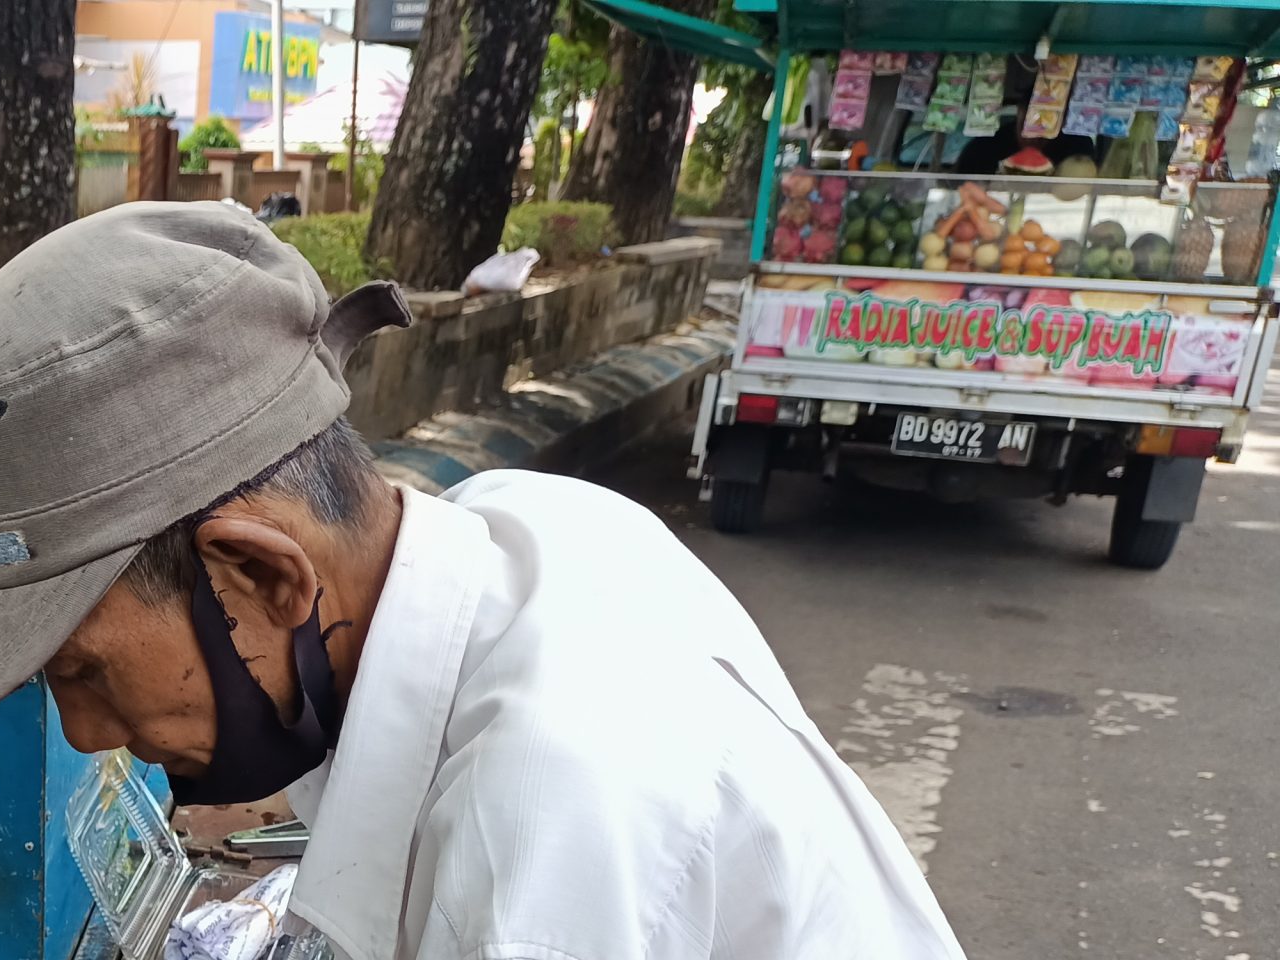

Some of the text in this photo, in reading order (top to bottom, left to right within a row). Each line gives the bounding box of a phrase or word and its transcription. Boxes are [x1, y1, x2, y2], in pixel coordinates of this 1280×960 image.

[915, 304, 998, 355] JUICE
[1026, 307, 1086, 361] SOP
[1085, 313, 1167, 367] BUAH
[899, 414, 1030, 451] BD 9972 AN
